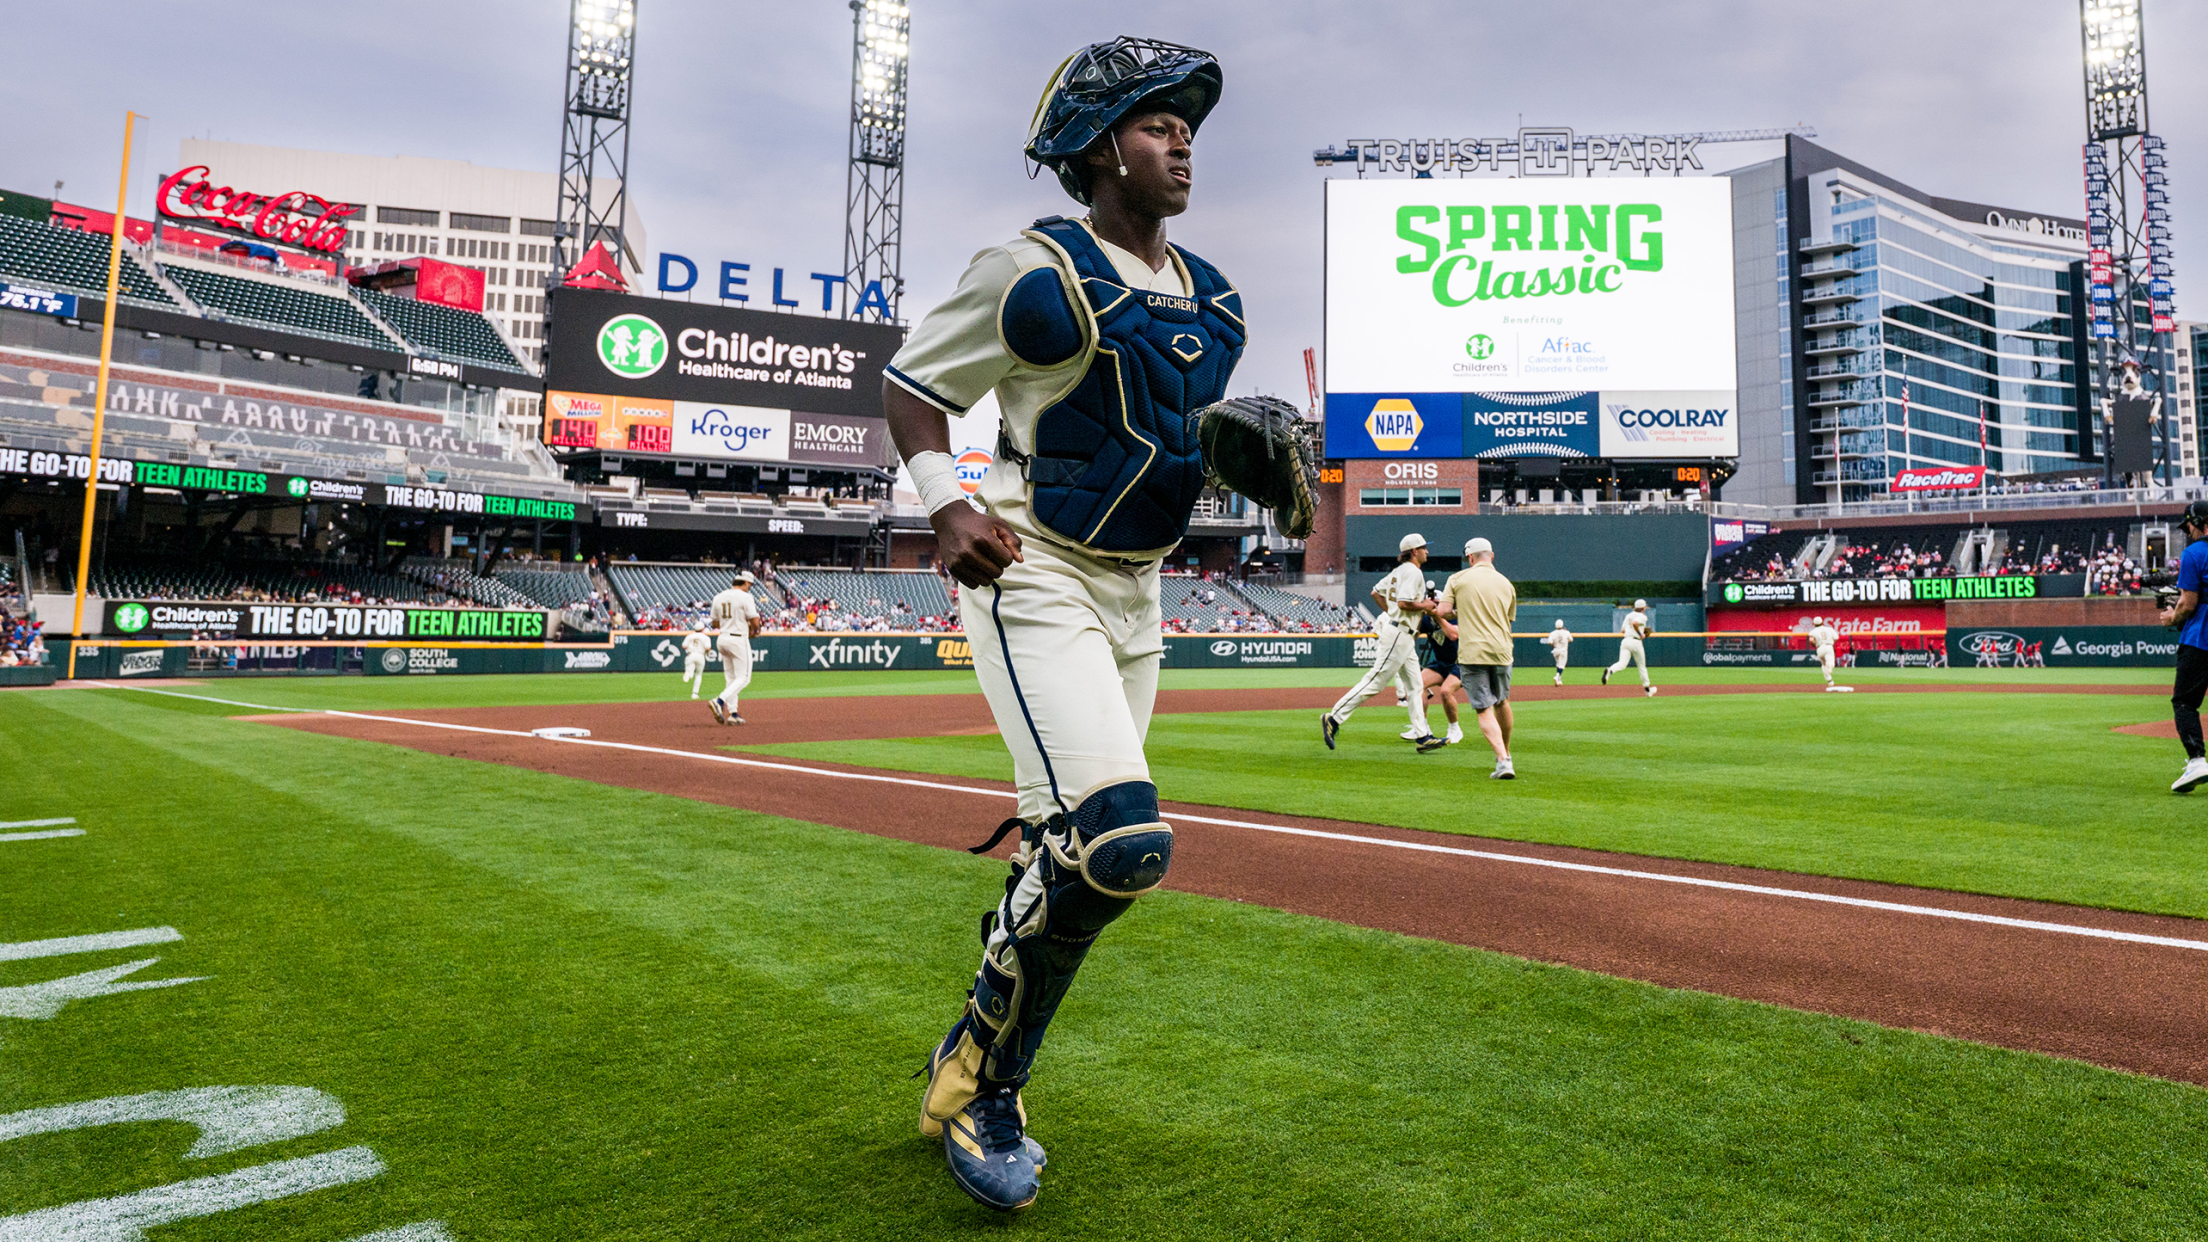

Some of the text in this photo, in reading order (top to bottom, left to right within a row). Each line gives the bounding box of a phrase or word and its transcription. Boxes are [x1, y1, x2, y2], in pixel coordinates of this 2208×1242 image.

[1347, 137, 1704, 172] TRUIST PARK
[156, 165, 359, 252] Coca-Cola
[1396, 204, 1663, 274] SPRING
[657, 252, 893, 319] DELTA
[1432, 254, 1623, 308] Classic
[1147, 294, 1198, 314] CATCHER U
[1502, 316, 1564, 325] Benefiting
[677, 328, 856, 373] Children's
[1453, 362, 1508, 372] Children's
[1528, 355, 1606, 364] Cancer & Blood
[439, 362, 459, 378] PM
[678, 360, 852, 390] Healthcare of Atlanta
[1524, 364, 1609, 373] Disorders Center
[1376, 414, 1414, 435] NAPA
[1474, 412, 1588, 426] NORTHSIDE
[1618, 409, 1729, 428] COOLRAY
[560, 420, 597, 438] 140
[636, 424, 672, 444] 100
[691, 409, 772, 451] Kroger
[794, 422, 868, 444] EMORY
[1495, 428, 1568, 437] HOSPITAL
[552, 436, 596, 447] MILLION
[630, 440, 672, 452] MILLION
[794, 441, 864, 454] HEALTHCARE
[136, 462, 179, 486] TEEN
[183, 467, 268, 494] ATHLETES
[1320, 469, 1344, 483] 0:20
[1384, 463, 1438, 479] ORIS
[1677, 468, 1700, 482] 0:20
[1898, 471, 1975, 488] RaceTrac
[310, 480, 364, 496] Children's
[385, 485, 575, 520] THE GO-TO FOR TEEN ATHLETES
[616, 512, 648, 527] TYPE:
[768, 519, 804, 533] SPEED:
[1744, 584, 1795, 595] Children's
[1800, 576, 2036, 602] THE GO-TO FOR TEEN ATHLETES
[152, 606, 239, 622] Children's
[720, 602, 732, 620] 11
[250, 607, 543, 637] THE GO-TO FOR TEEN ATHLETES
[409, 648, 448, 658] SOUTH
[809, 638, 901, 668] xfinity
[1241, 642, 1312, 655] HYUNDAI
[2076, 641, 2127, 658] Georgia
[408, 658, 458, 668] COLLEGE
